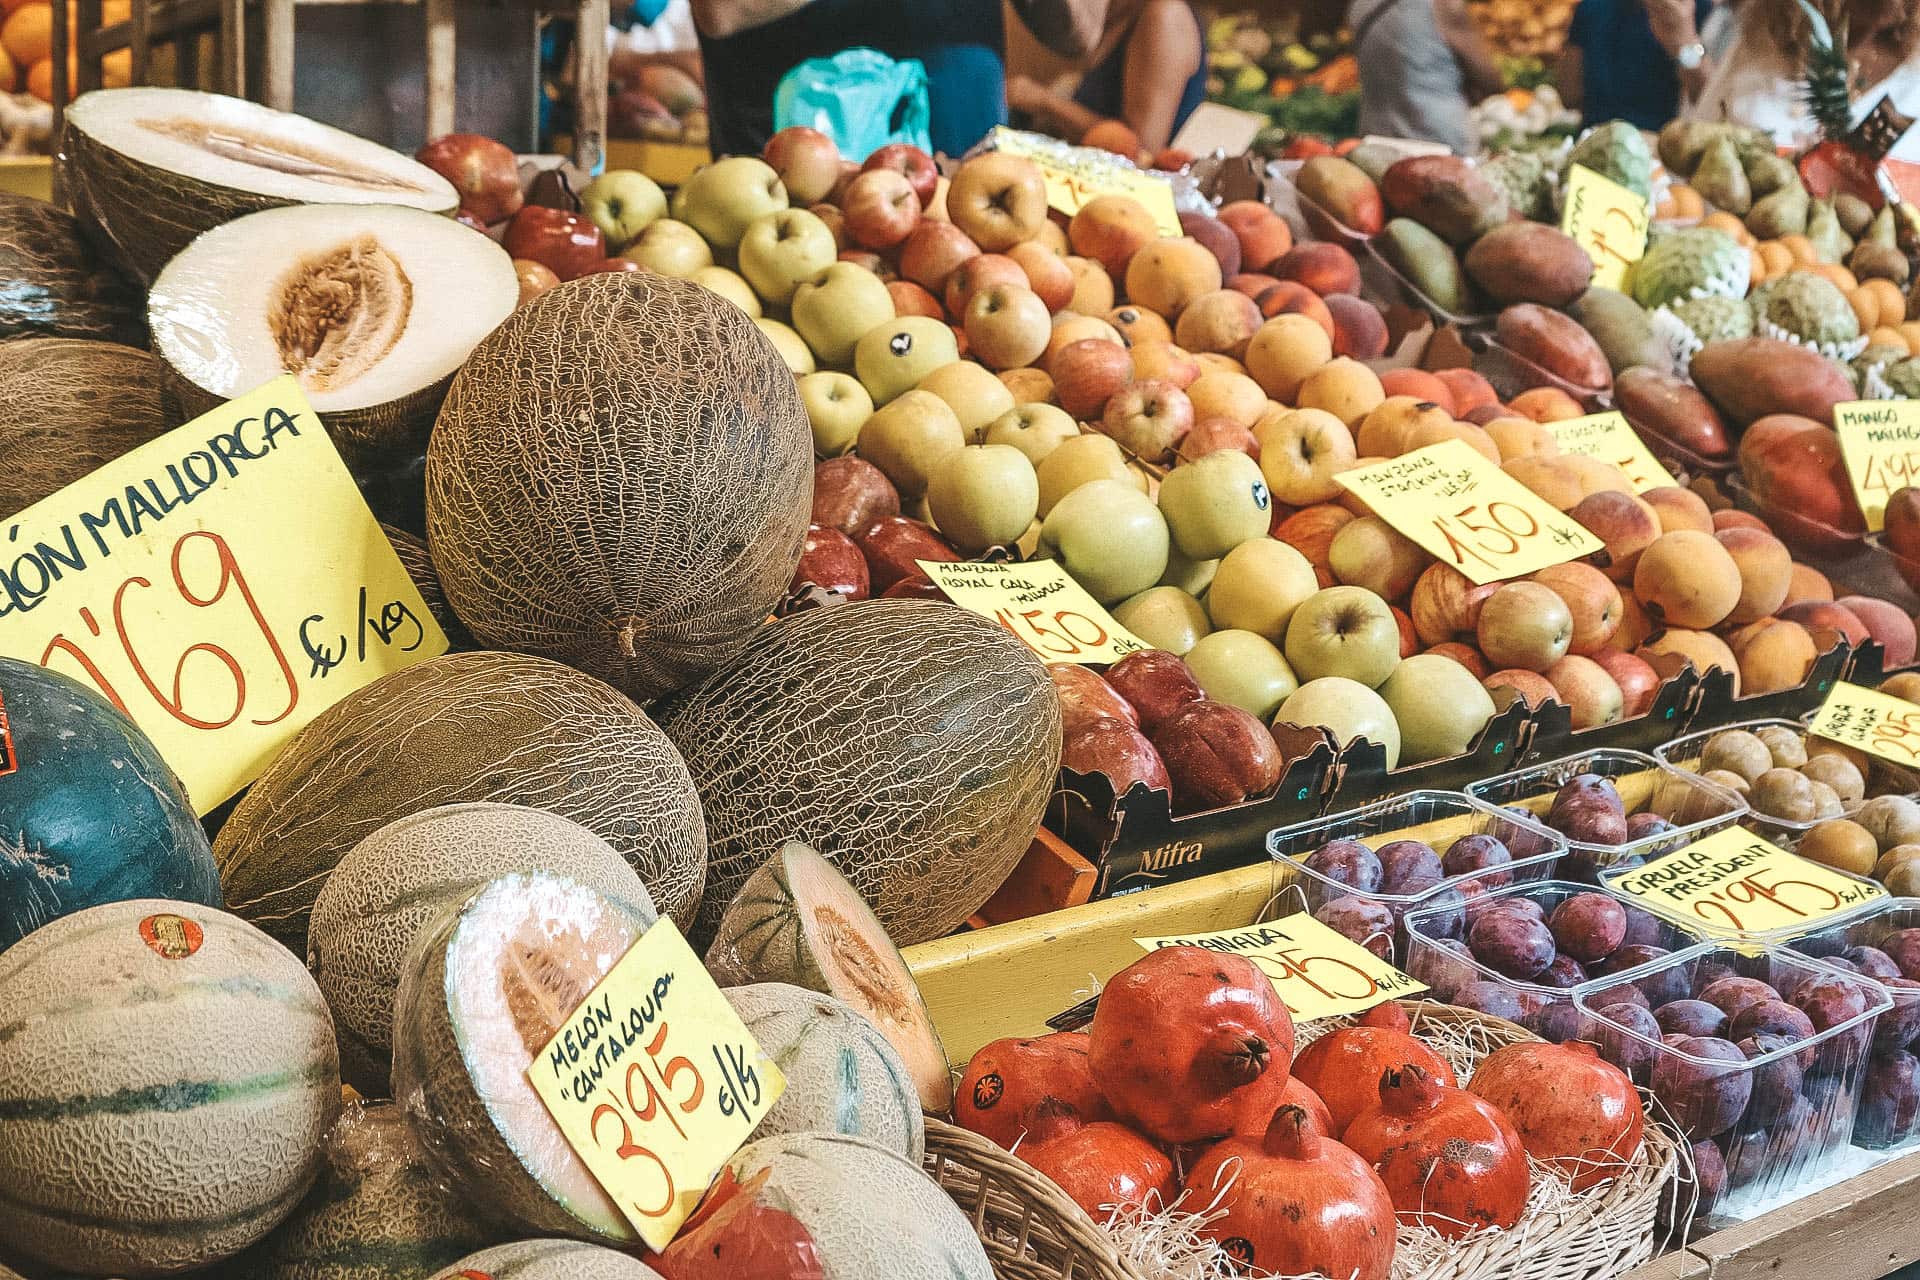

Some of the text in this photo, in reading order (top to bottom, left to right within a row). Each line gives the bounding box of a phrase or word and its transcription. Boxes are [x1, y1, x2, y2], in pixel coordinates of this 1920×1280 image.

[0, 407, 302, 618] LÓN MALLORCA
[1139, 840, 1203, 873] Mifra
[550, 993, 612, 1079] MELÓN
